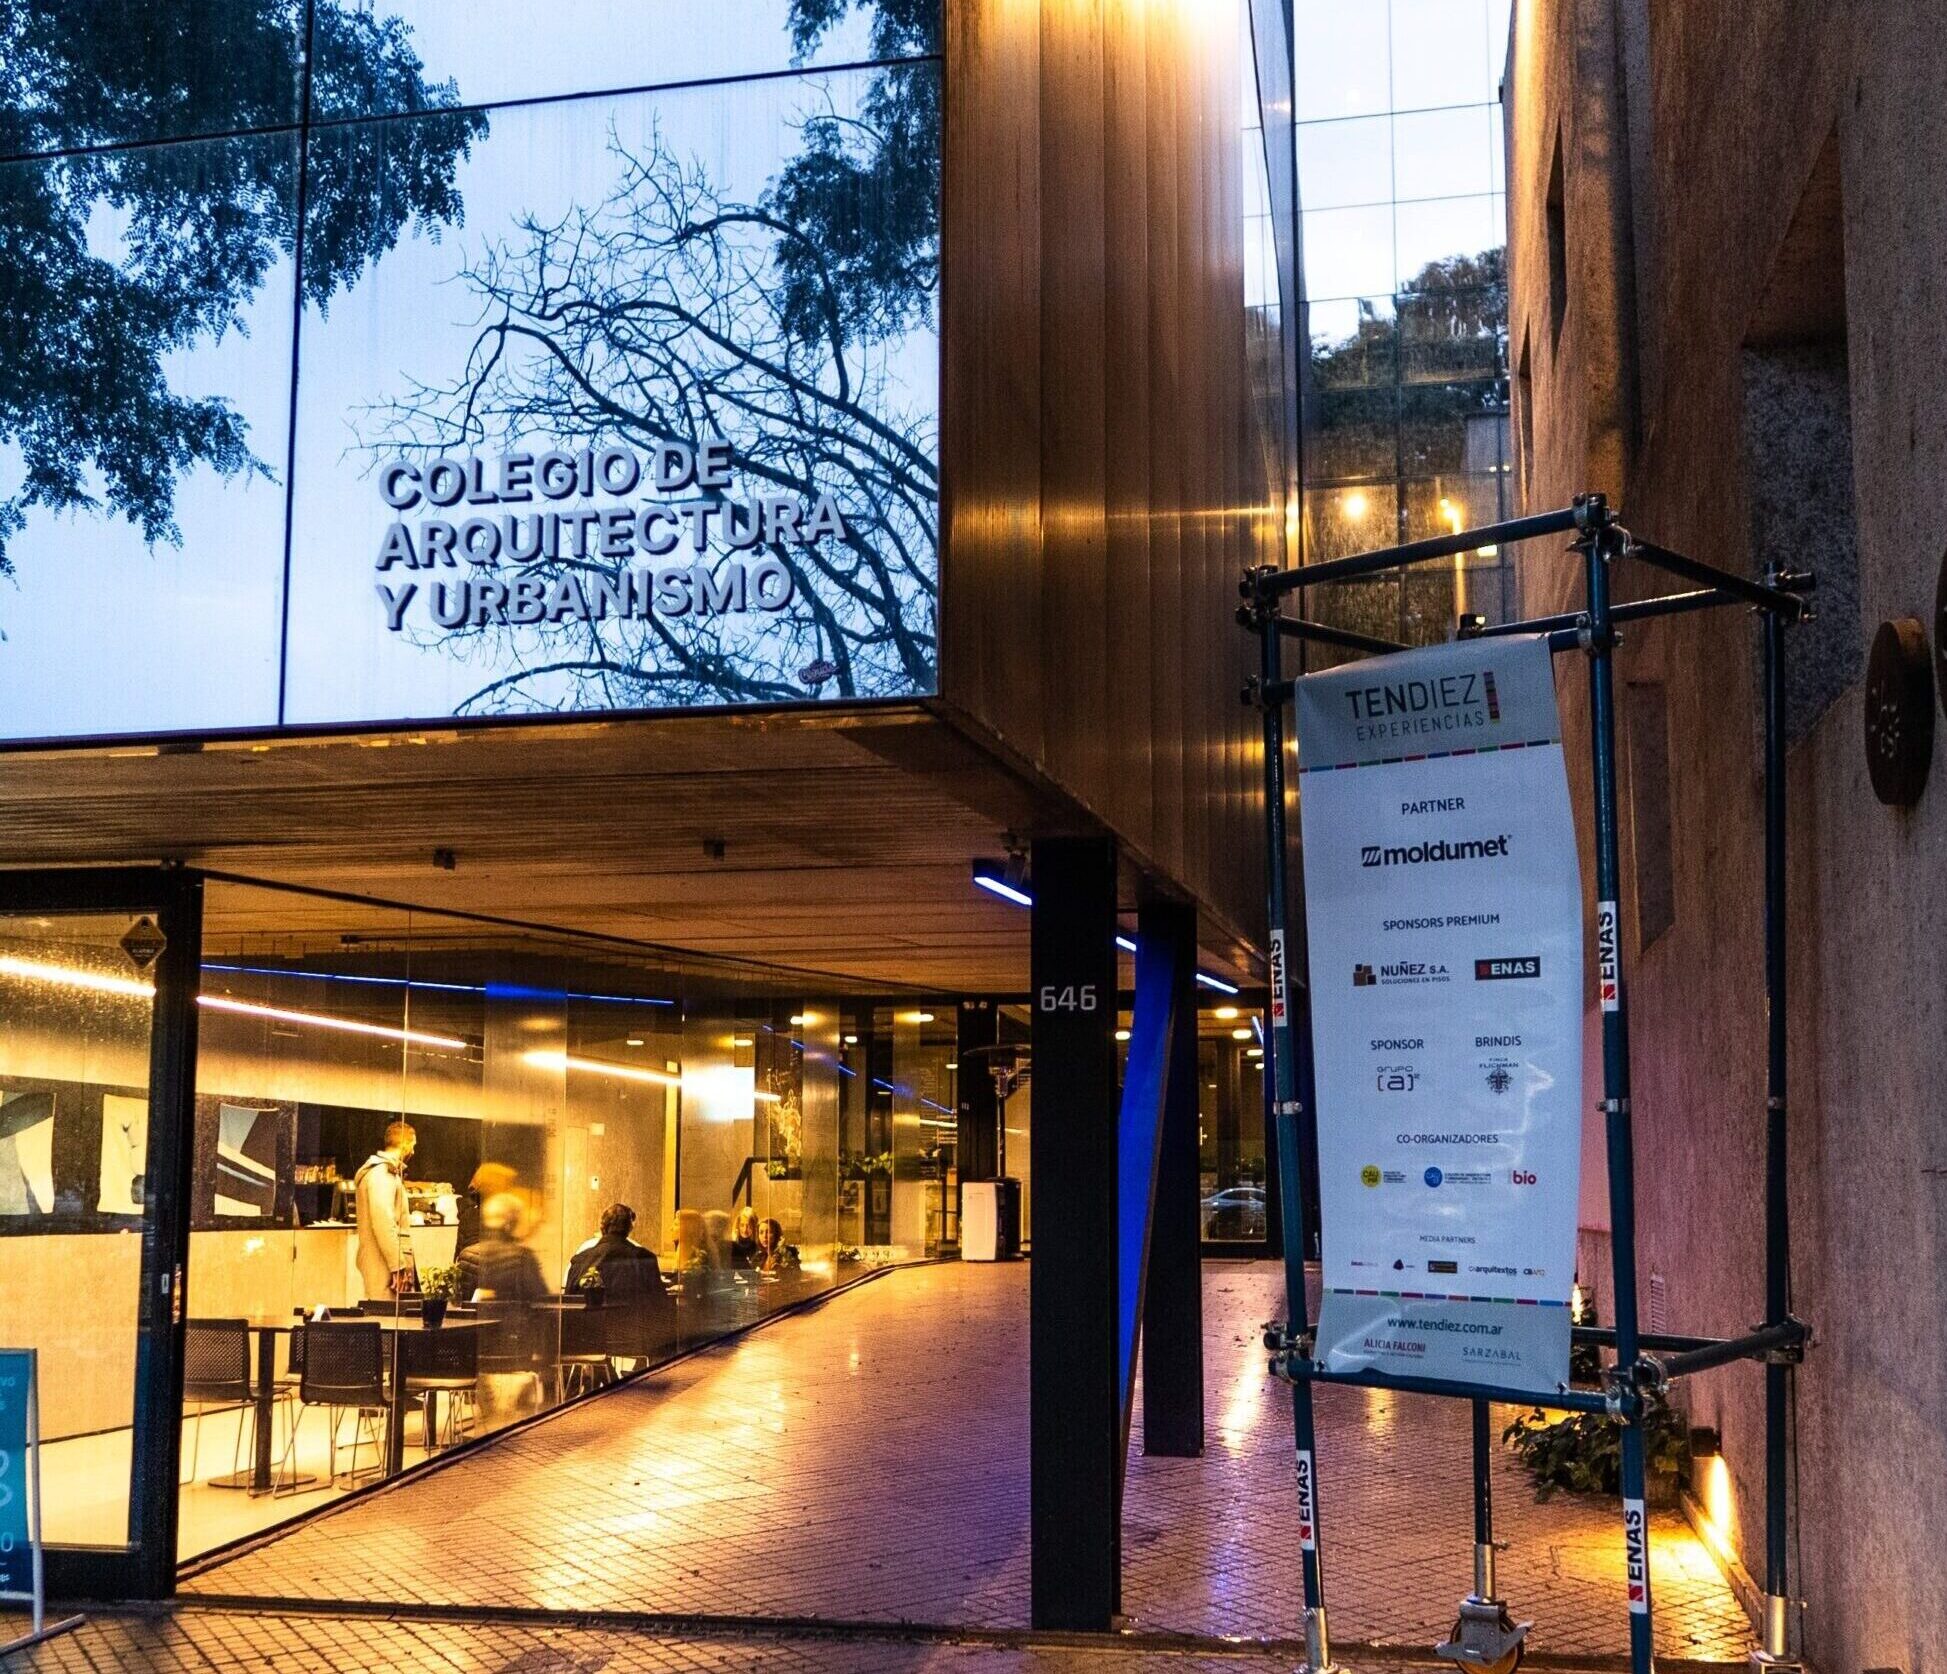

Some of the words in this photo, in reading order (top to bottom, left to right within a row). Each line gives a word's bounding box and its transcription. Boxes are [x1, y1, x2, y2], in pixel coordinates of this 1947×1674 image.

[378, 446, 641, 510] COLEGIO
[653, 438, 733, 493] DE
[375, 496, 849, 571] ARQUITECTURA
[375, 582, 418, 632] Y
[429, 560, 798, 629] URBANISMO
[1345, 674, 1481, 719] TENDIEZ
[1356, 710, 1485, 742] EXPERIENCIAS
[1401, 797, 1466, 815] PARTNER
[1384, 834, 1509, 865] moldumet
[1382, 916, 1444, 931] SPONSORS
[1446, 913, 1500, 927] PREMIUM
[1600, 911, 1615, 980] ENAS
[1271, 939, 1283, 999] ENAS
[1381, 961, 1426, 976] NUÑEZ
[1429, 965, 1450, 975] S.A.
[1490, 961, 1536, 976] ENAS
[1040, 985, 1097, 1011] 646
[1370, 1038, 1425, 1050] SPONSOR
[1475, 1035, 1522, 1047] BRINDIS
[1396, 1134, 1499, 1144] CO-ORGANIZADORES
[1512, 1170, 1537, 1185] bio
[1419, 1235, 1440, 1243] MEDIA
[1442, 1235, 1476, 1244] PARTNERS
[1387, 1317, 1504, 1335] www.tendiez.com.ar
[1364, 1338, 1392, 1350] ALICIA
[1393, 1341, 1426, 1352] FALCONI
[1462, 1346, 1521, 1360] SARZABAL
[1298, 1460, 1311, 1521] ENAS
[1625, 1510, 1642, 1581] ENAS
